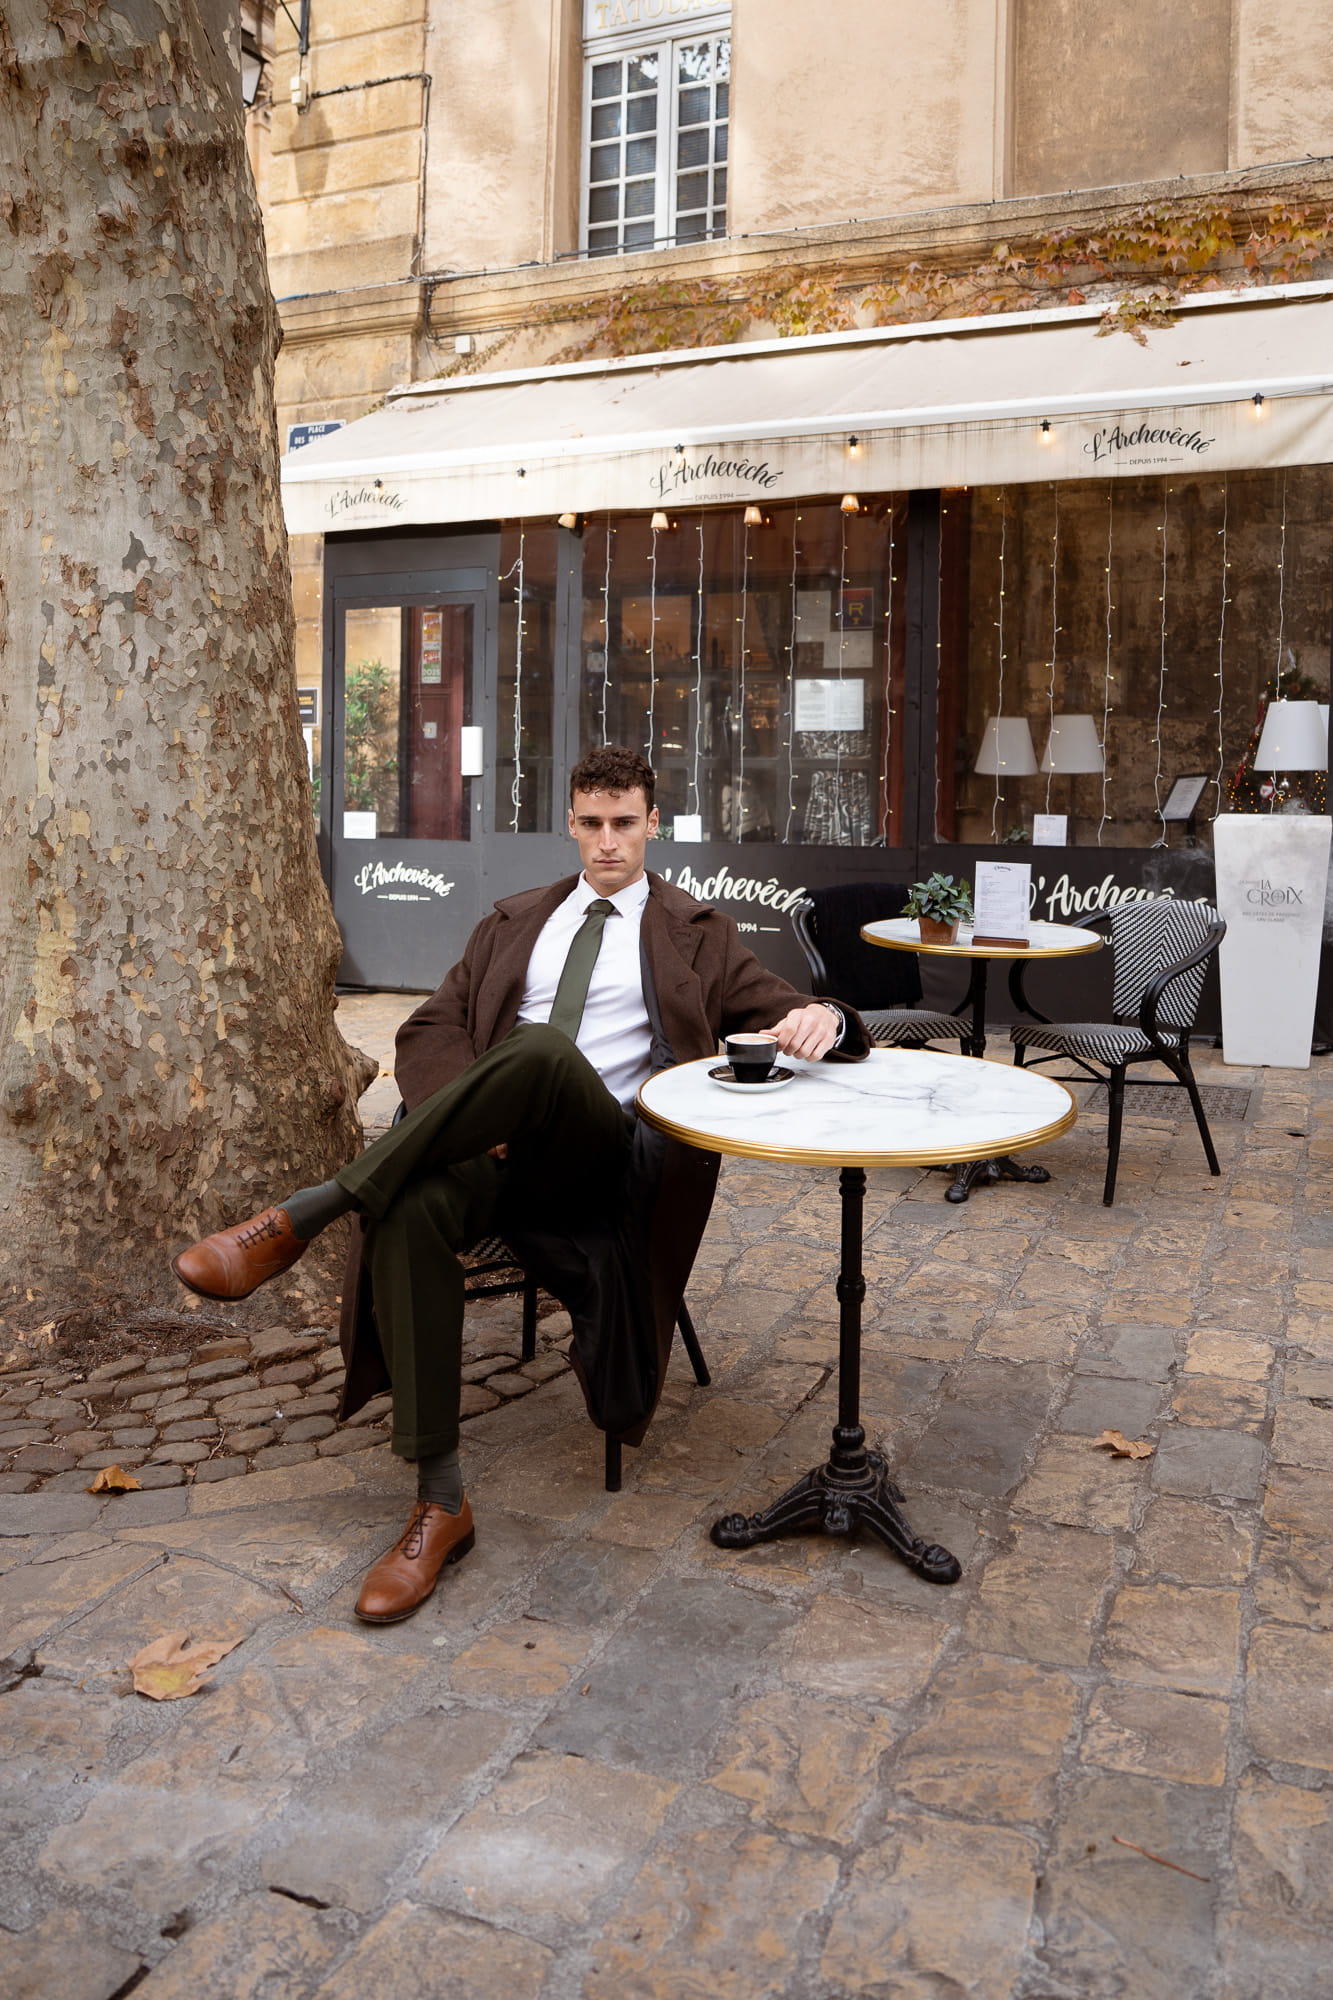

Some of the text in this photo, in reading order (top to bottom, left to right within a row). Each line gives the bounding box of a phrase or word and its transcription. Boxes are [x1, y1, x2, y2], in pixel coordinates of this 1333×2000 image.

[594, 0, 732, 29] TATOU
[308, 425, 326, 434] PLACE
[1083, 423, 1216, 462] L'Archevêché
[1129, 456, 1168, 466] DEPUIS 1994
[650, 454, 784, 498] L'Archevêché
[354, 861, 455, 897] L'Archevêché
[656, 866, 815, 918] 'Archevêch
[1246, 886, 1304, 907] CROIX
[737, 923, 757, 932] 1994
